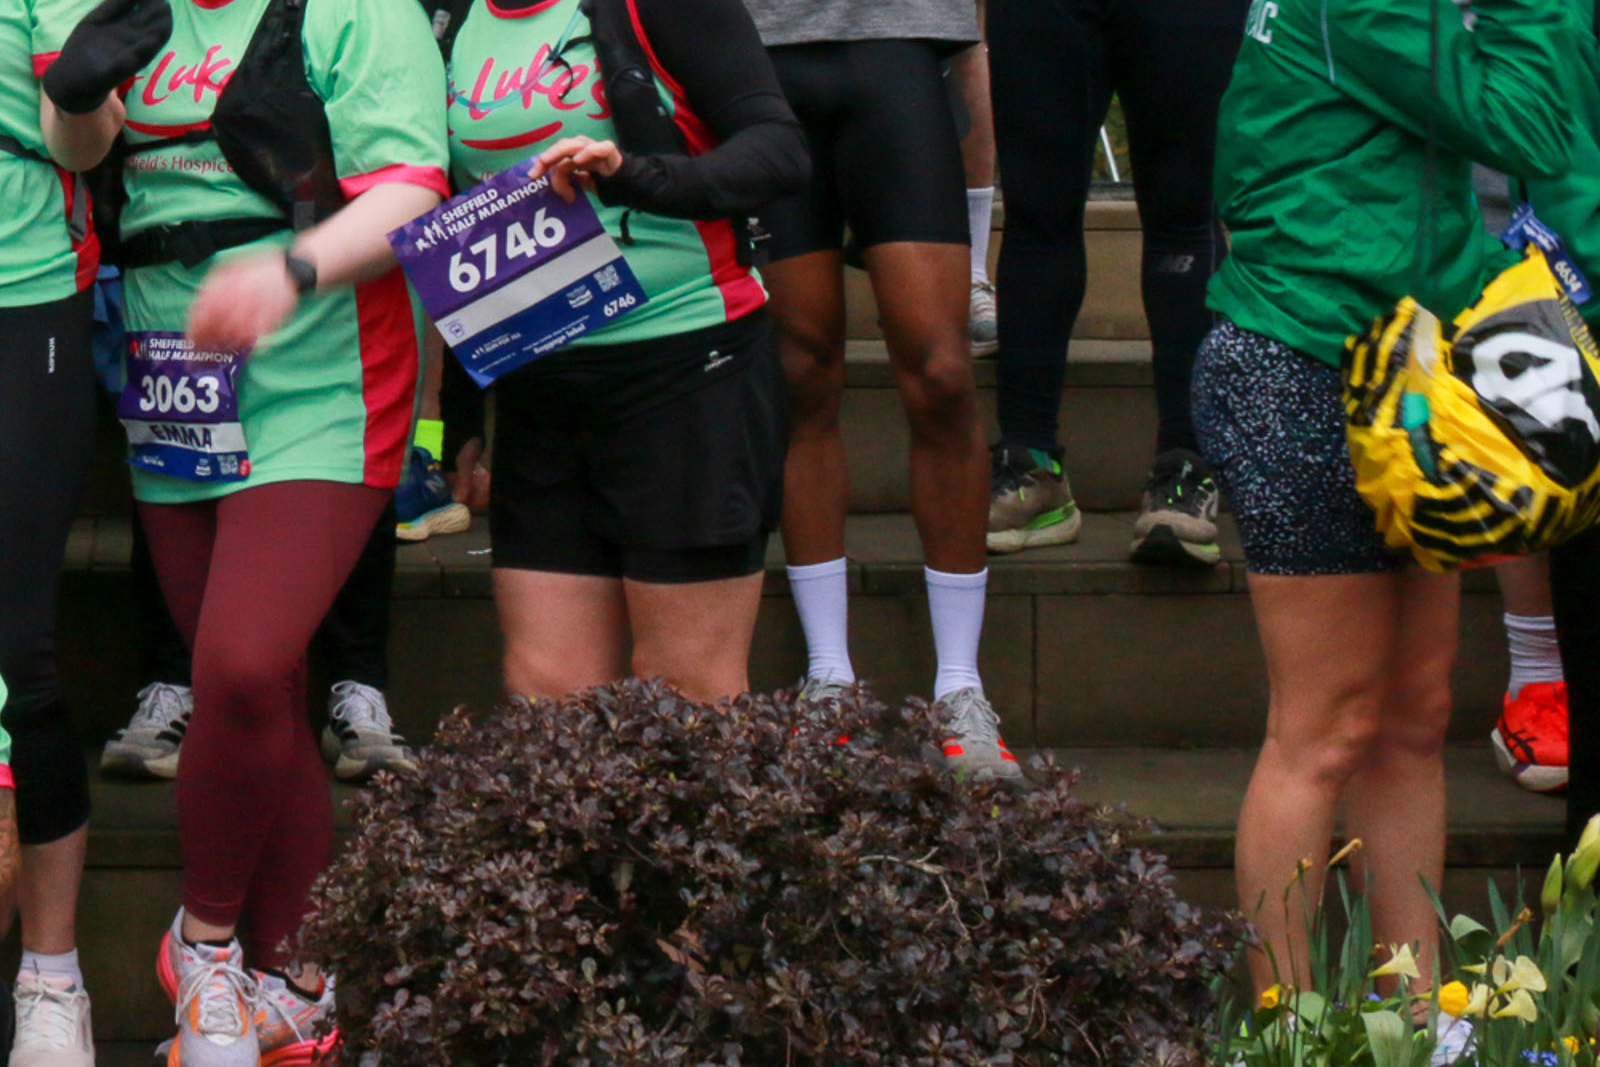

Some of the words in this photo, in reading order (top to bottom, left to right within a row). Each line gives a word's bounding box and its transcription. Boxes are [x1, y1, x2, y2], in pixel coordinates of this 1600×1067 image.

[441, 187, 498, 225] SHEFFIELD
[446, 213, 477, 236] HALF
[478, 176, 549, 218] MARATHON
[448, 207, 566, 293] 6746
[603, 293, 636, 318] 6746
[150, 338, 195, 349] SHEFFIELD
[171, 351, 233, 363] MARATHON
[139, 375, 219, 413] 3063
[149, 424, 212, 449] EMMA
